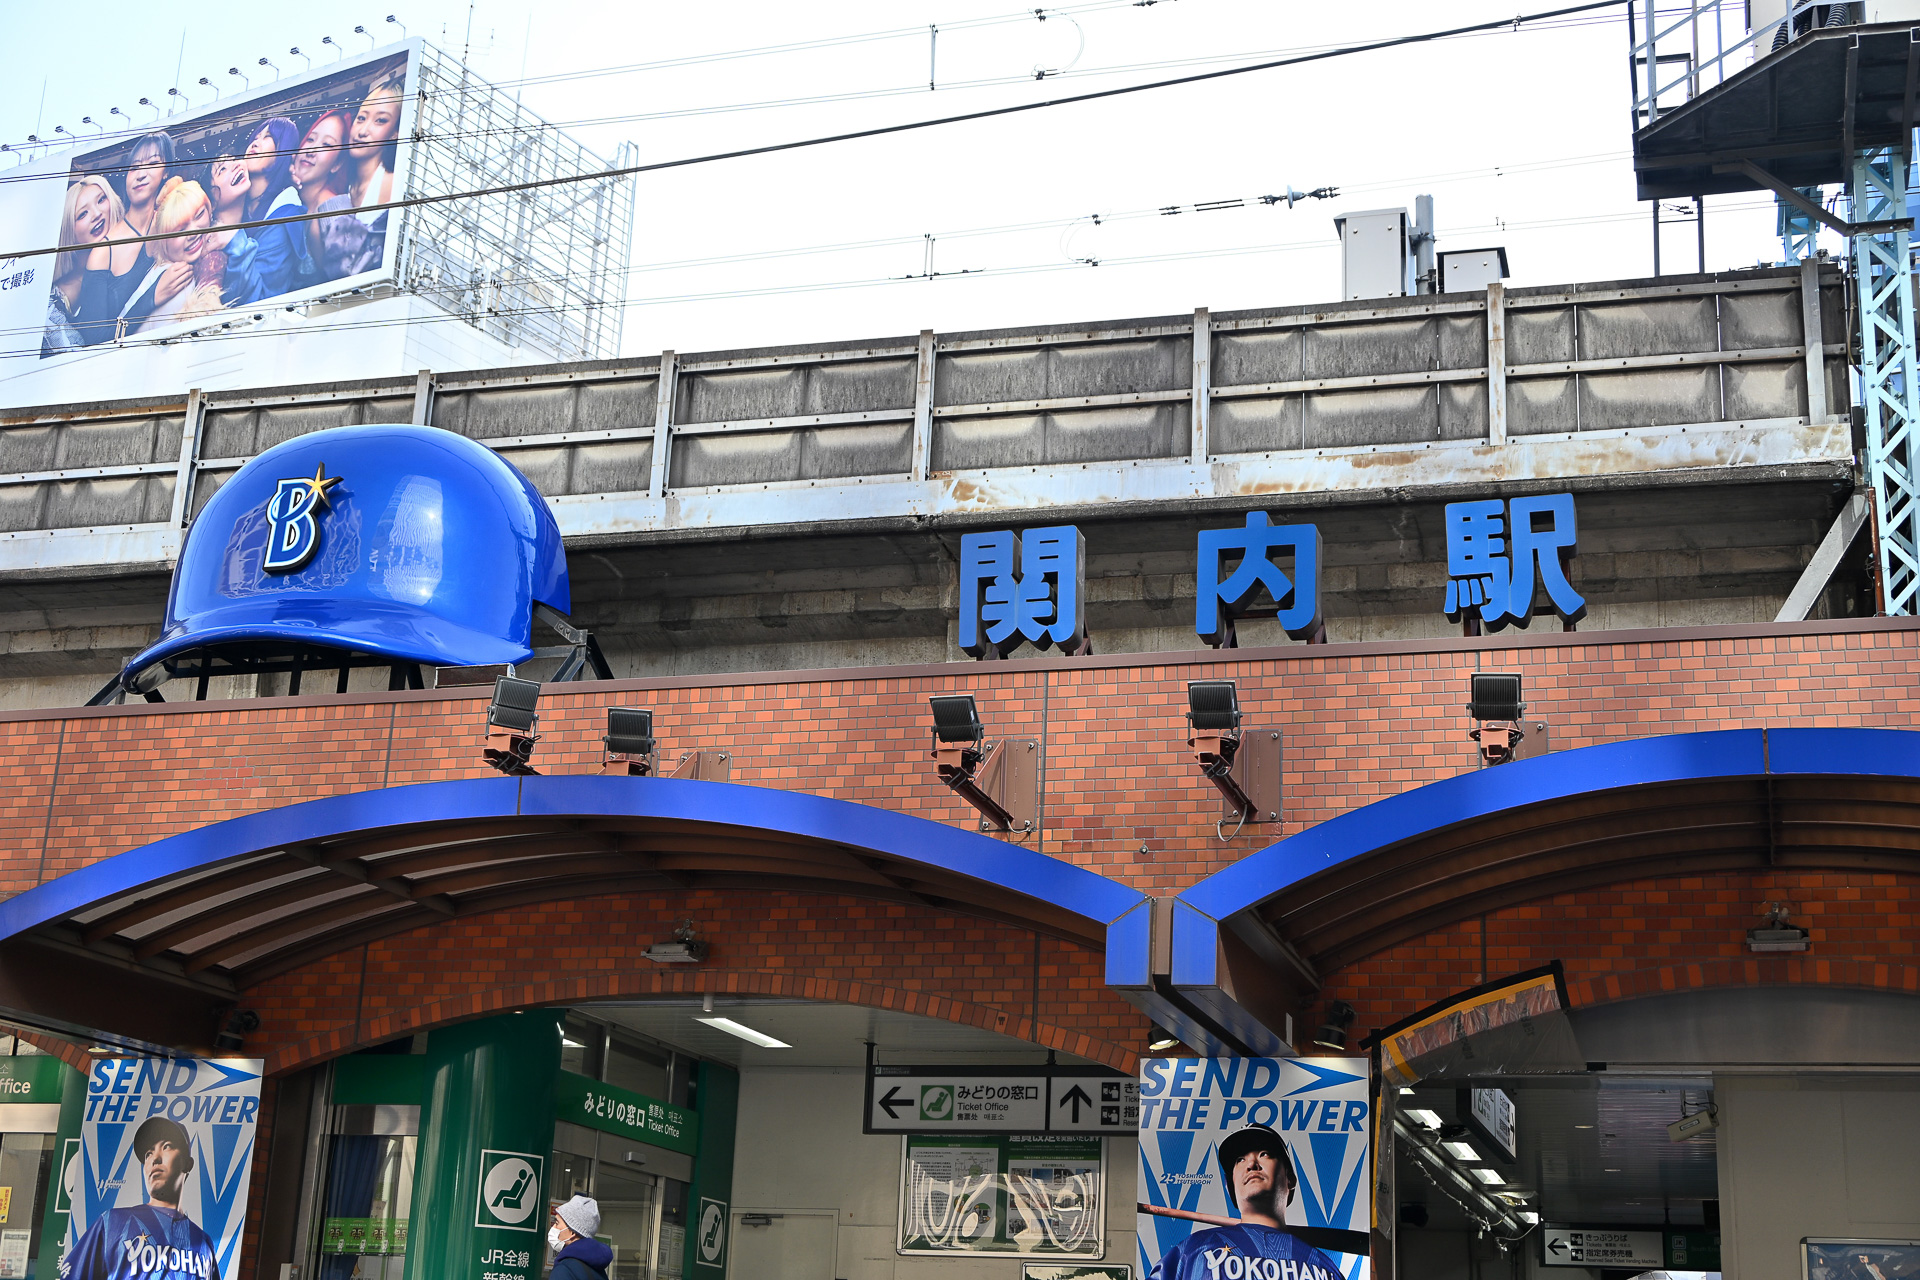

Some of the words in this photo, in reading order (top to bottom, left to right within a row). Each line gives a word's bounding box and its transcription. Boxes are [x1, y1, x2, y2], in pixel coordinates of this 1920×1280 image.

[0, 269, 35, 290] で撮影
[959, 493, 1586, 657] 関内駅
[88, 1059, 198, 1094] SEND
[1140, 1058, 1281, 1098] SEND
[957, 1085, 1039, 1101] みどりの窓口
[86, 1095, 142, 1122] THE
[146, 1095, 260, 1123] POWER
[584, 1092, 646, 1128] みどりの窓口
[957, 1102, 982, 1111] Ticket
[984, 1102, 1009, 1111] Office
[1140, 1099, 1211, 1130] THE
[1219, 1099, 1369, 1132] POWER
[957, 1113, 978, 1121] 售票处
[983, 1113, 1005, 1121] 매표소
[648, 1118, 664, 1133] Ticket
[664, 1124, 680, 1138] Office
[1160, 1173, 1176, 1184] 25
[1585, 1233, 1628, 1242] きっぷうりば
[123, 1234, 215, 1280] YOKOHAM
[481, 1249, 530, 1268] JR全線
[1585, 1249, 1633, 1258] 指定席券売機
